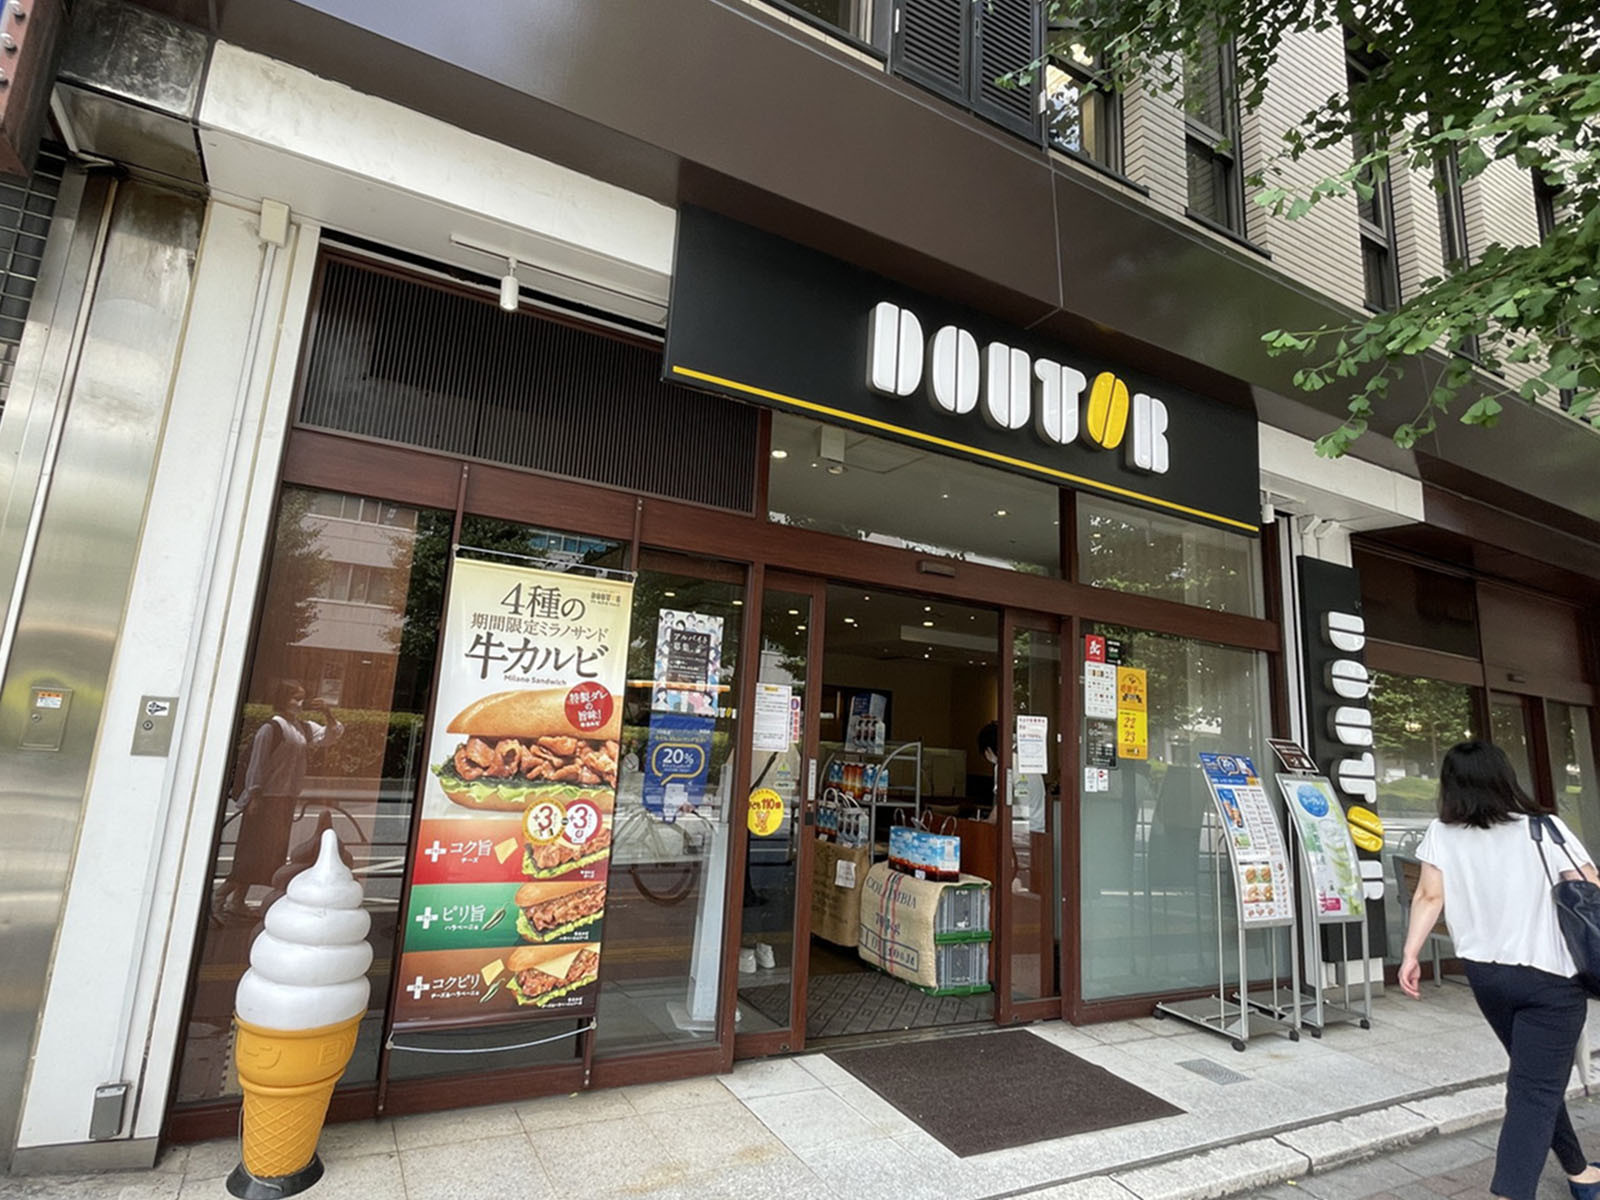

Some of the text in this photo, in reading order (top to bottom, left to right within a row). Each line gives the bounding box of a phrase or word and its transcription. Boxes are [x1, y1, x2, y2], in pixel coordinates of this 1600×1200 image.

[869, 301, 1169, 474] DOUTOR
[501, 583, 585, 621] 4種の
[471, 613, 608, 642] 期間限定ミラノサンド
[464, 632, 609, 679] 牛カルビ
[504, 674, 567, 686] Milano Sandwich
[662, 748, 694, 765] 20%
[1326, 611, 1386, 901] DOUTOR
[866, 876, 917, 908] COLMBIA
[432, 973, 480, 991] コクピリ
